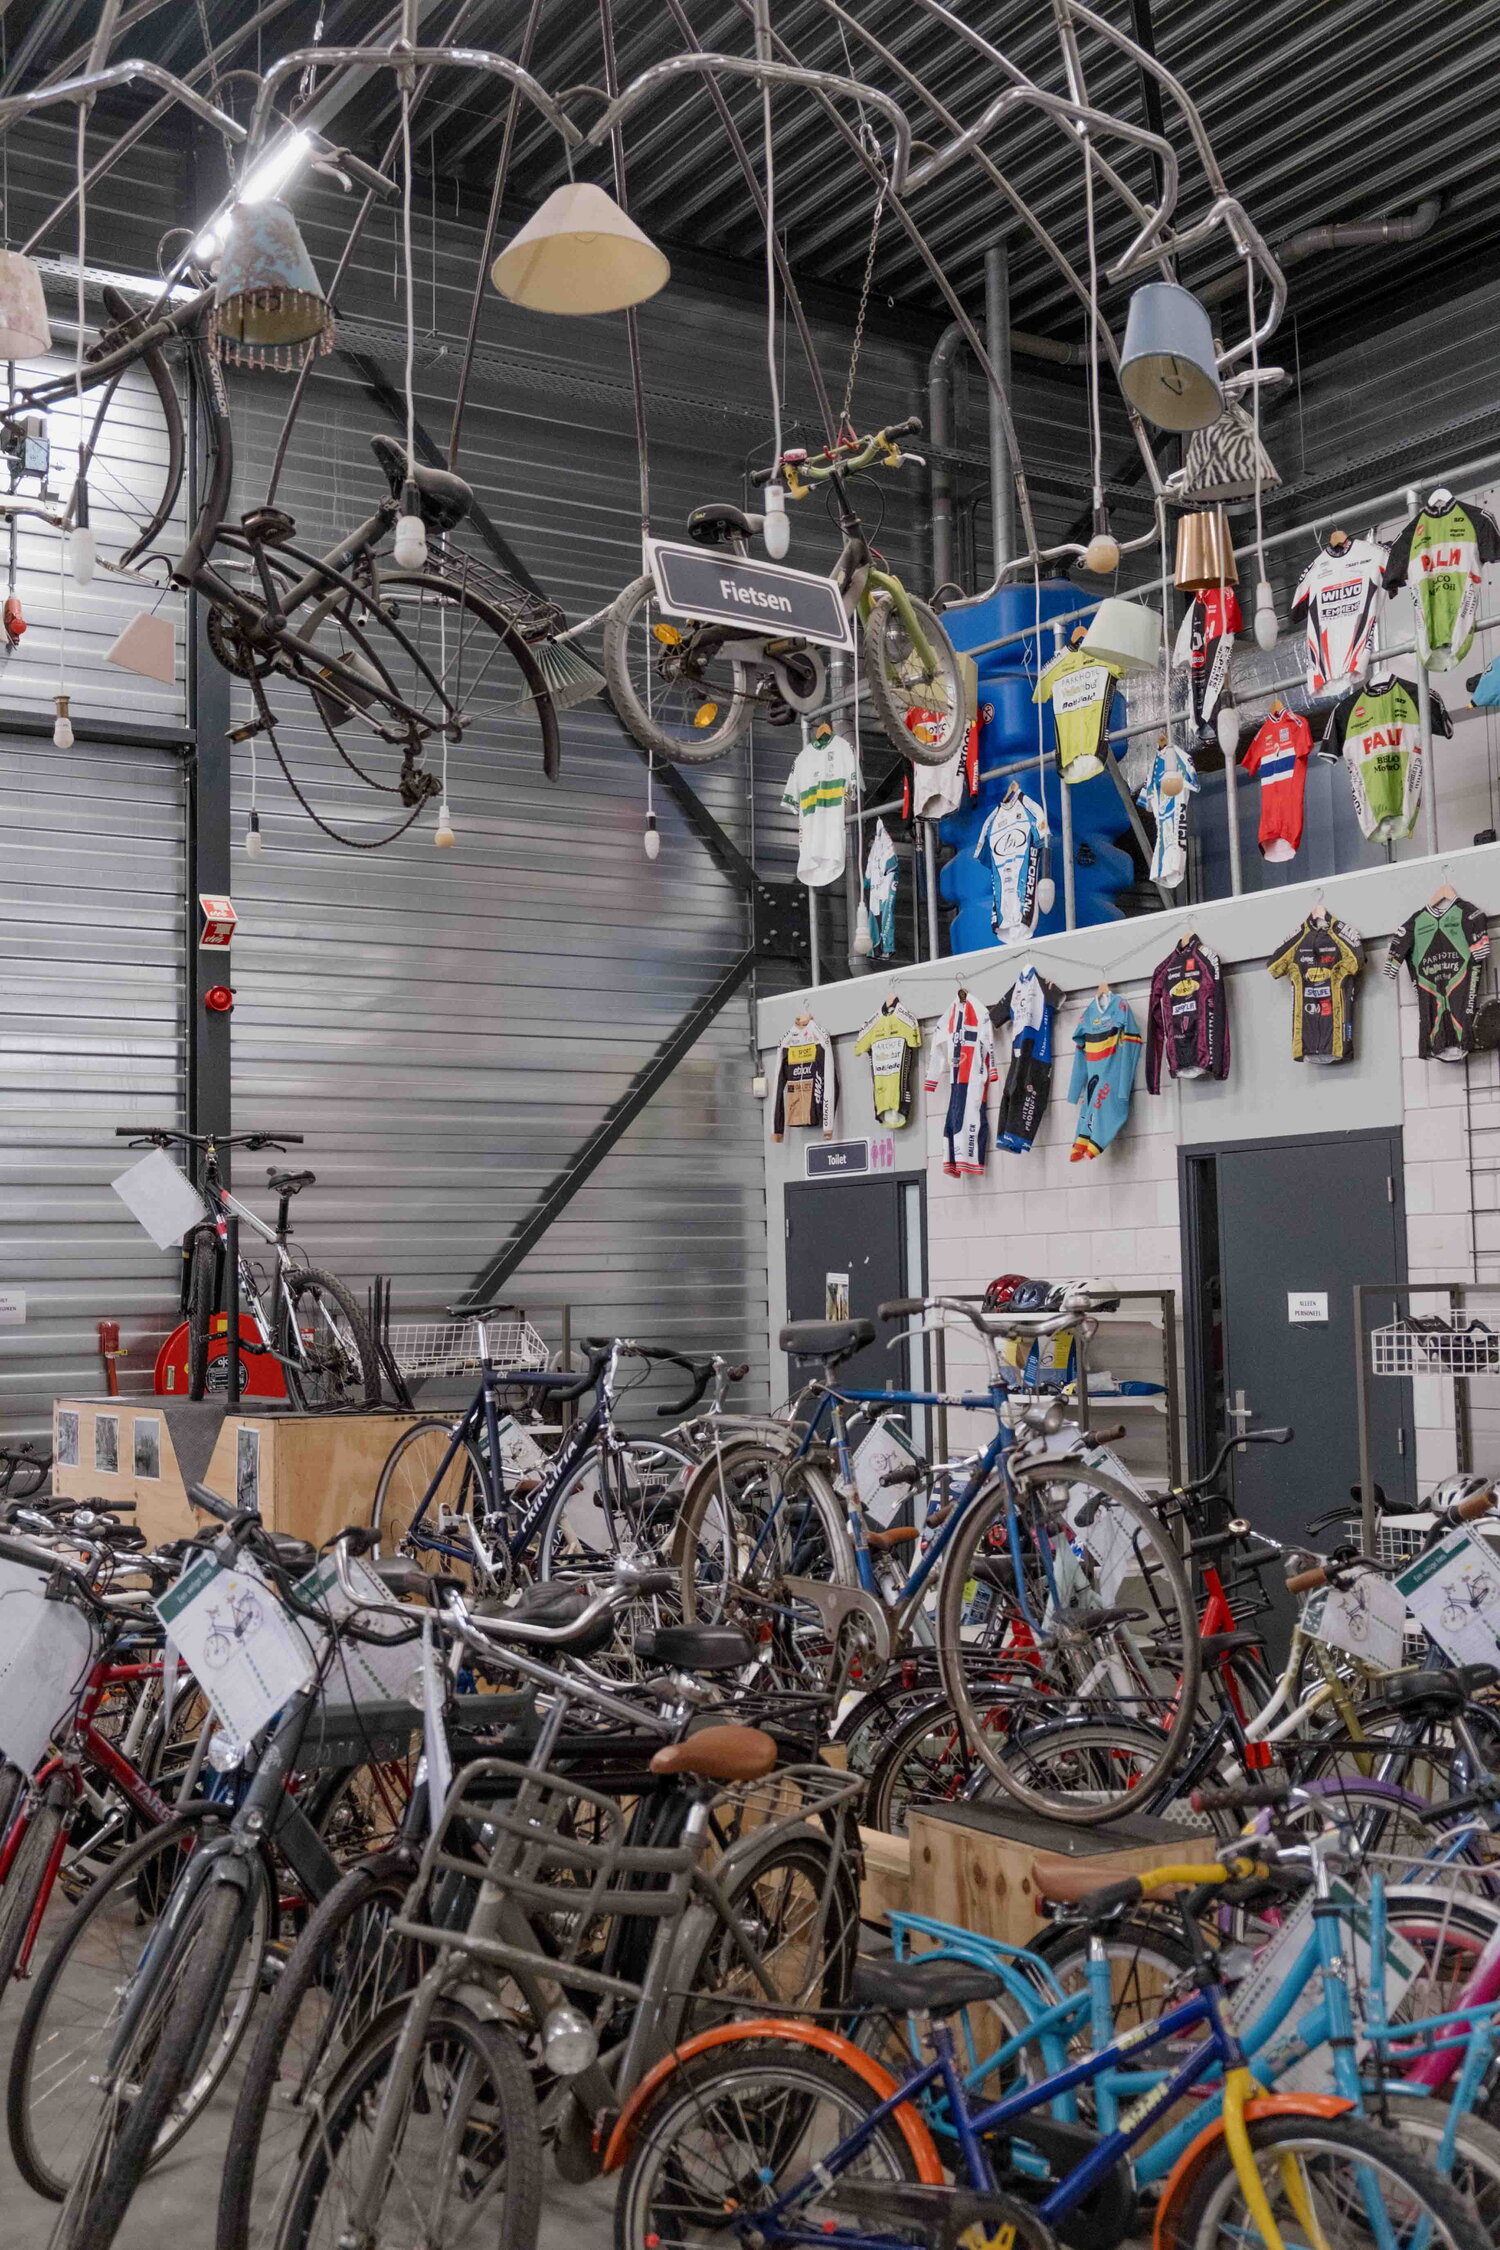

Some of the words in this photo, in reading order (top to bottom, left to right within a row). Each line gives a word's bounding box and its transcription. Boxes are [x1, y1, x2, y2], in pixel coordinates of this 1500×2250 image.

[720, 579, 792, 613] Fietsen
[1322, 583, 1362, 603] WILVO
[1466, 965, 1481, 1015] Valkenburg
[827, 1153, 847, 1166] Toilet
